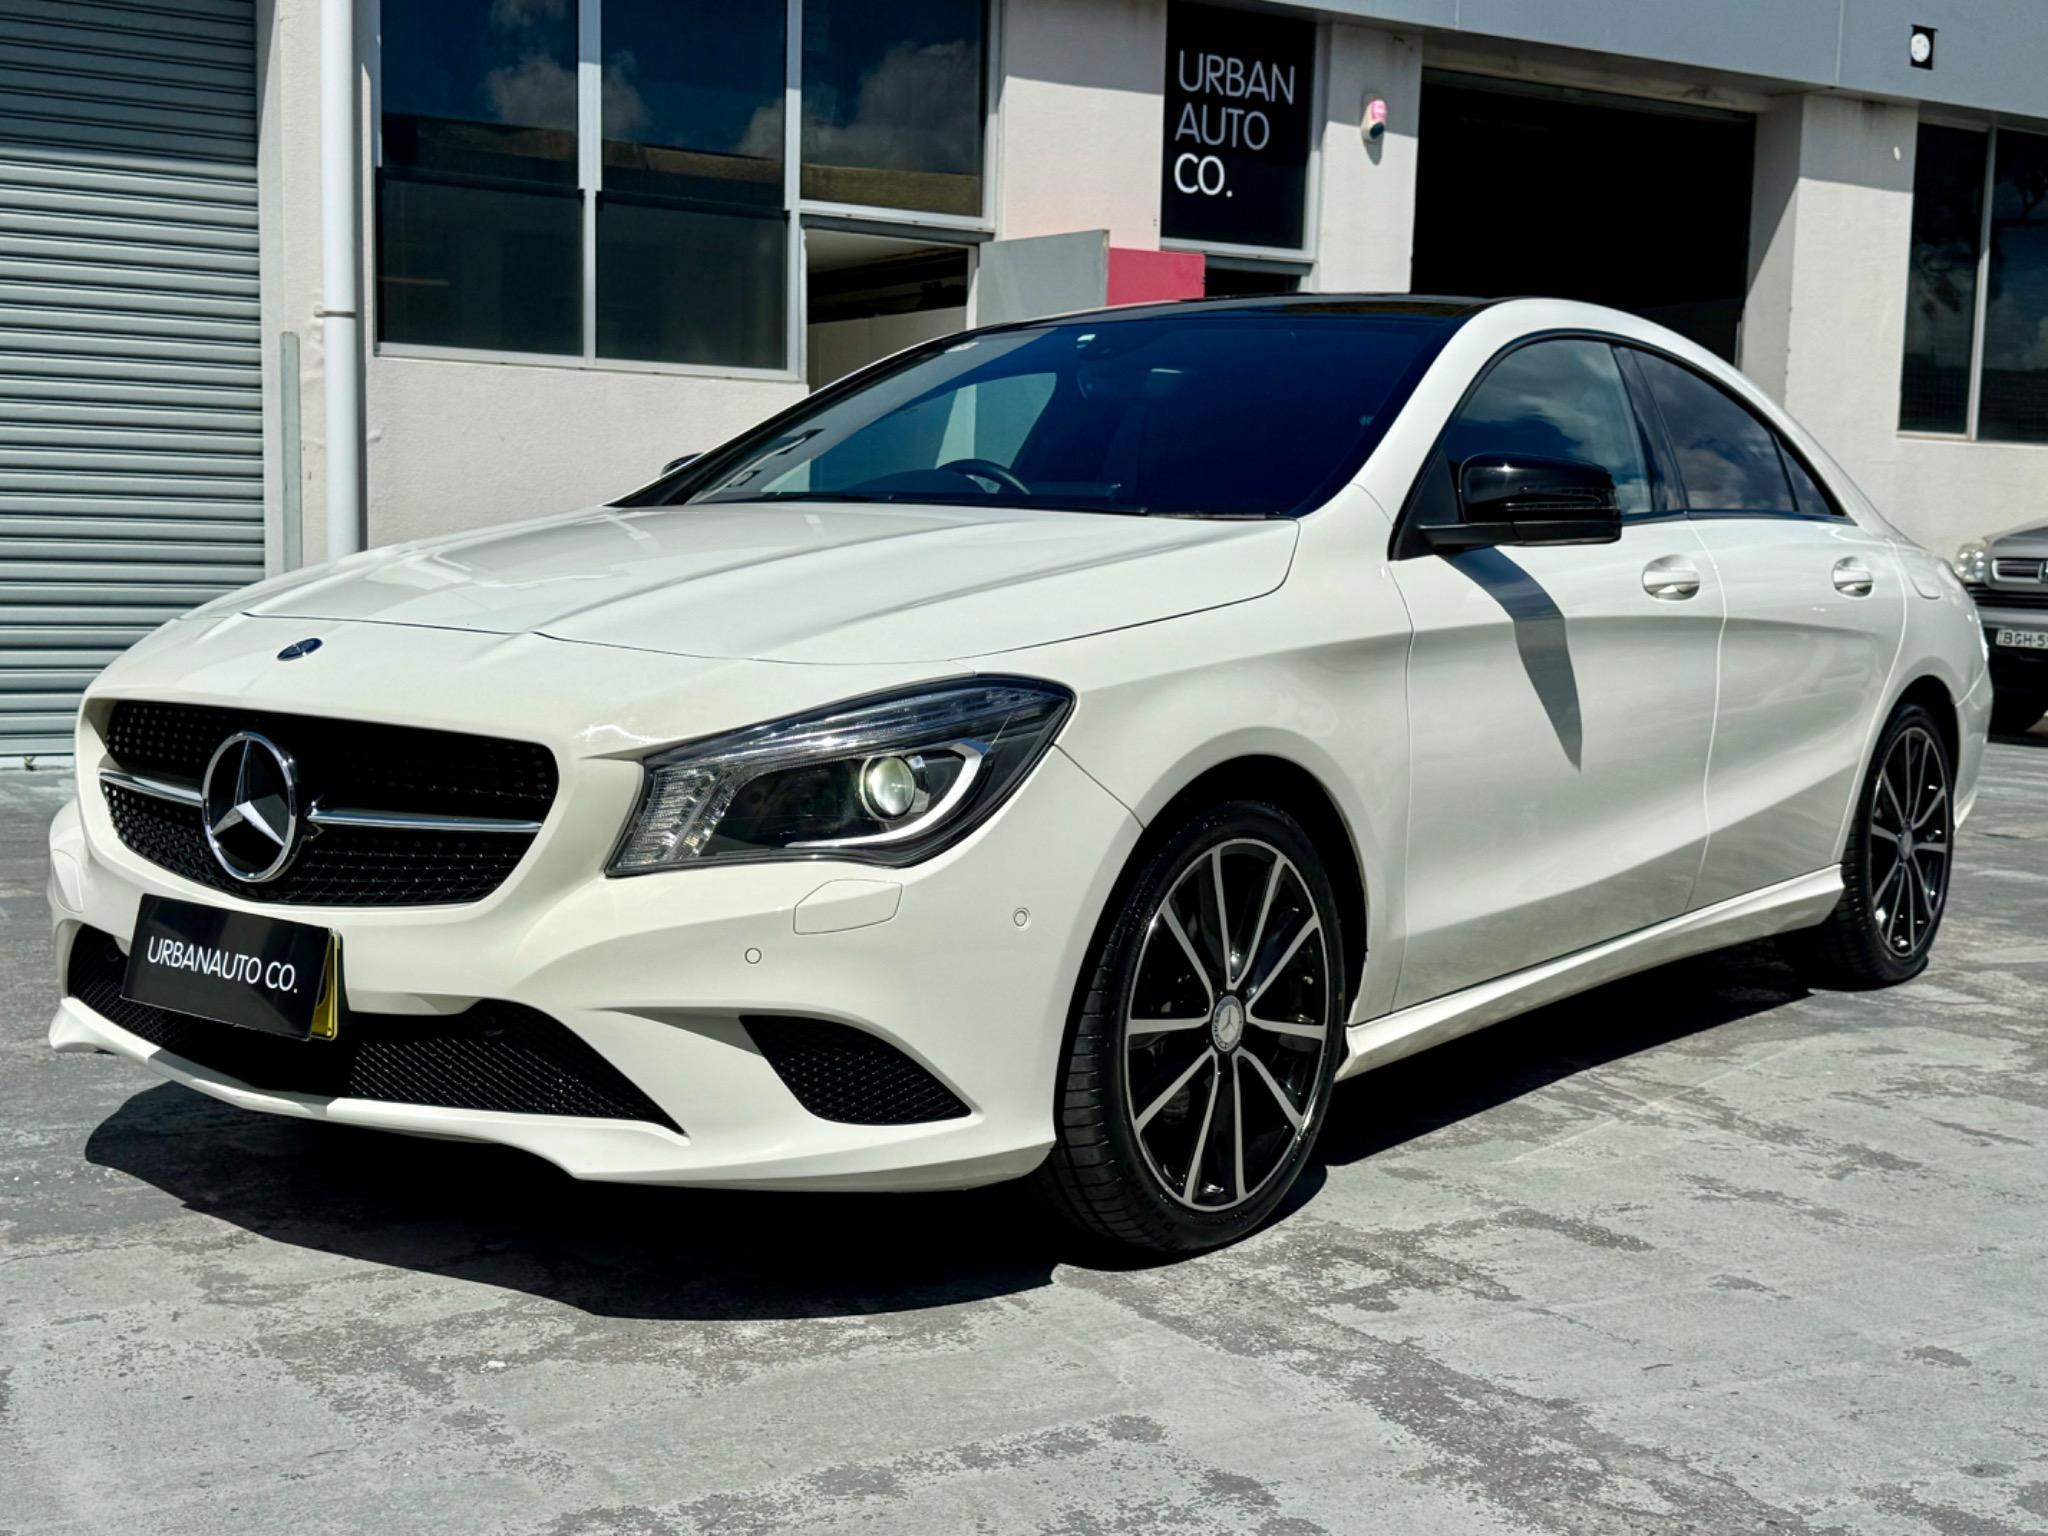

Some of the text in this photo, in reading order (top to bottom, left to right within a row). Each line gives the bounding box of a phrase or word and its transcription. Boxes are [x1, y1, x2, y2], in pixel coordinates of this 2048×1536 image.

[1178, 50, 1295, 104] URBAN
[1175, 102, 1270, 150] AUTO
[1174, 152, 1233, 197] CO.
[147, 935, 299, 993] URBANAUTO CO.
